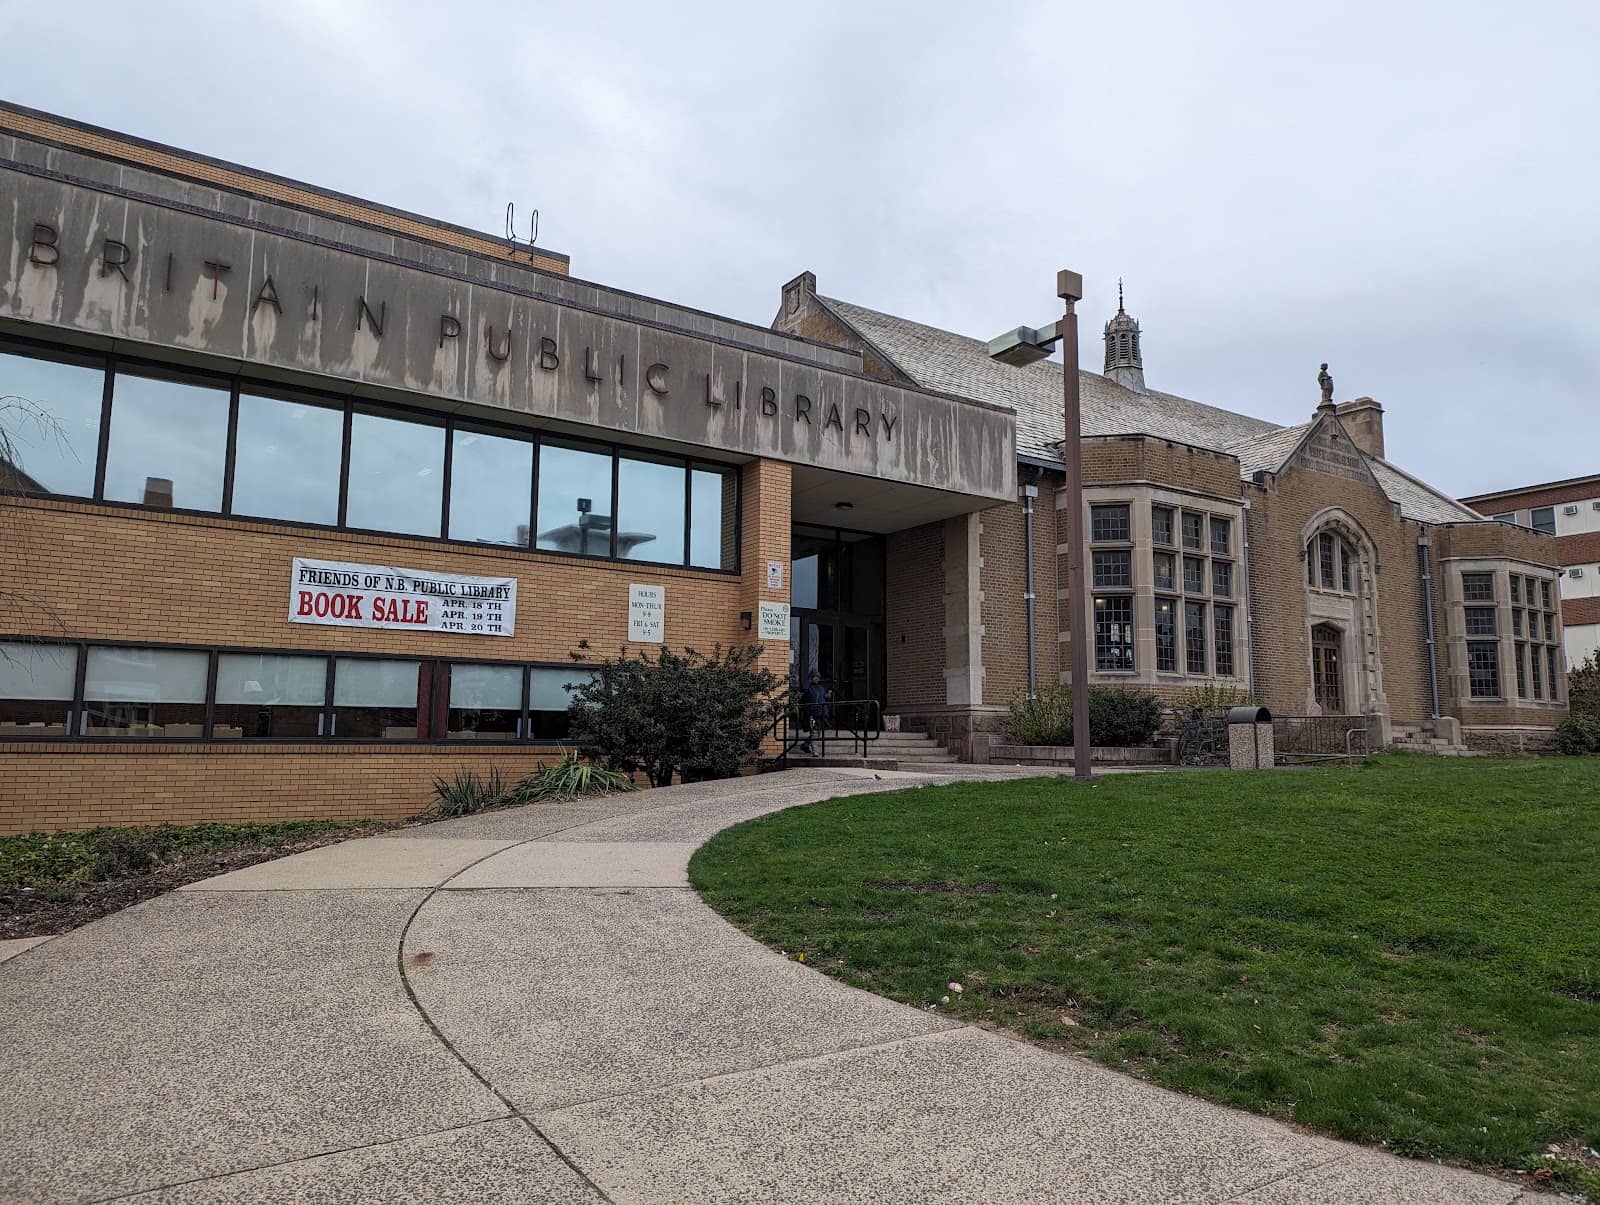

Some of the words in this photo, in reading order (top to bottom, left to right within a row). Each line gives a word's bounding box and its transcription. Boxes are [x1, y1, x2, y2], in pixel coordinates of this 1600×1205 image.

[30, 224, 386, 337] BRITAIN
[438, 314, 670, 395] PUBLIC
[705, 372, 898, 441] LIBRARY
[299, 569, 359, 587] FRIENDS
[364, 575, 381, 589] OF
[385, 577, 408, 592] N.B.
[413, 580, 456, 595] PUBLIC
[461, 585, 511, 600] LIBRARY
[297, 590, 364, 620] BOOK
[372, 596, 429, 624] SALE
[442, 599, 468, 609] APR.
[472, 601, 483, 609] 18
[486, 602, 502, 611] TH
[441, 610, 468, 620] APR.
[472, 612, 483, 621] 19
[486, 613, 503, 622] TH
[762, 611, 773, 619] DO
[773, 612, 787, 620] NOT
[441, 621, 468, 631] APR.
[471, 623, 483, 631] 20
[486, 624, 502, 633] TH
[650, 620, 660, 629] SAT
[763, 618, 785, 626] SMOKE
